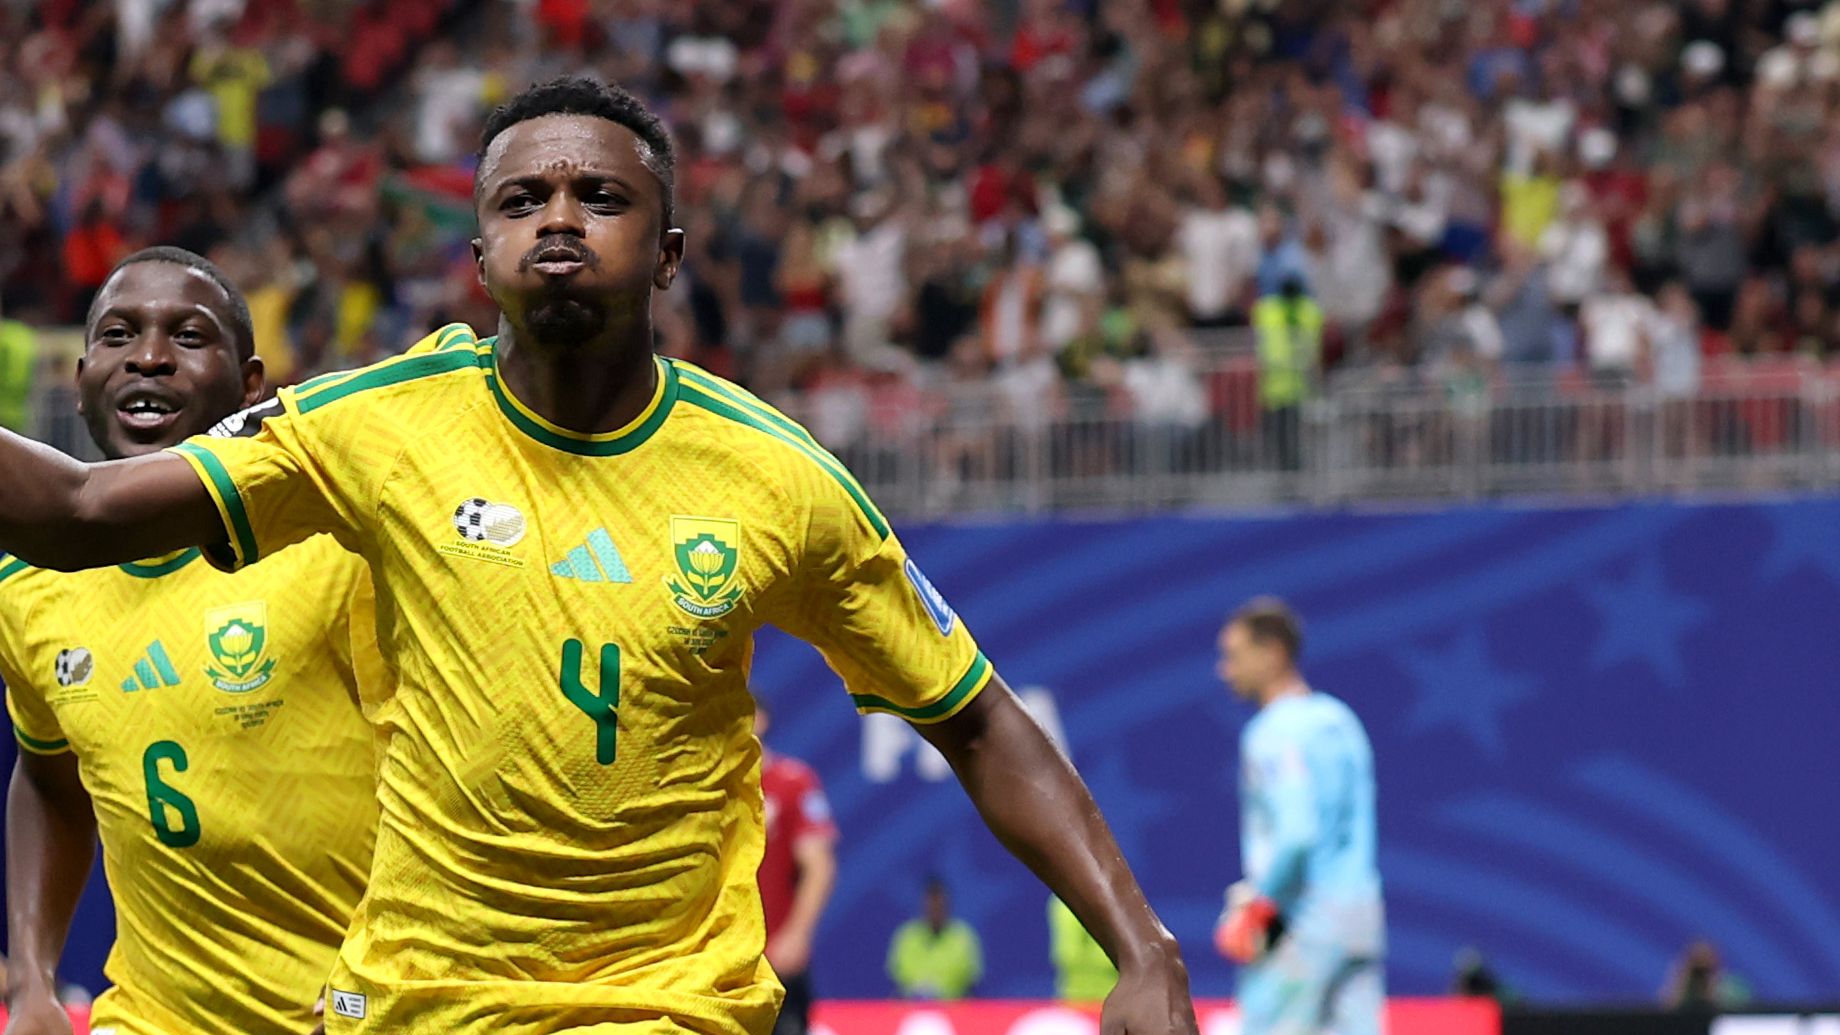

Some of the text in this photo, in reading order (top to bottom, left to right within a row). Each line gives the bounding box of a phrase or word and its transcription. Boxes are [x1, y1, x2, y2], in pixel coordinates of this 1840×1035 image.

[440, 545, 475, 557] FOOTBALL
[456, 541, 511, 556] SOUTH AFRICAN
[678, 597, 729, 616] SOUTH AFRICA
[559, 637, 621, 766] 4
[142, 740, 201, 848] 6
